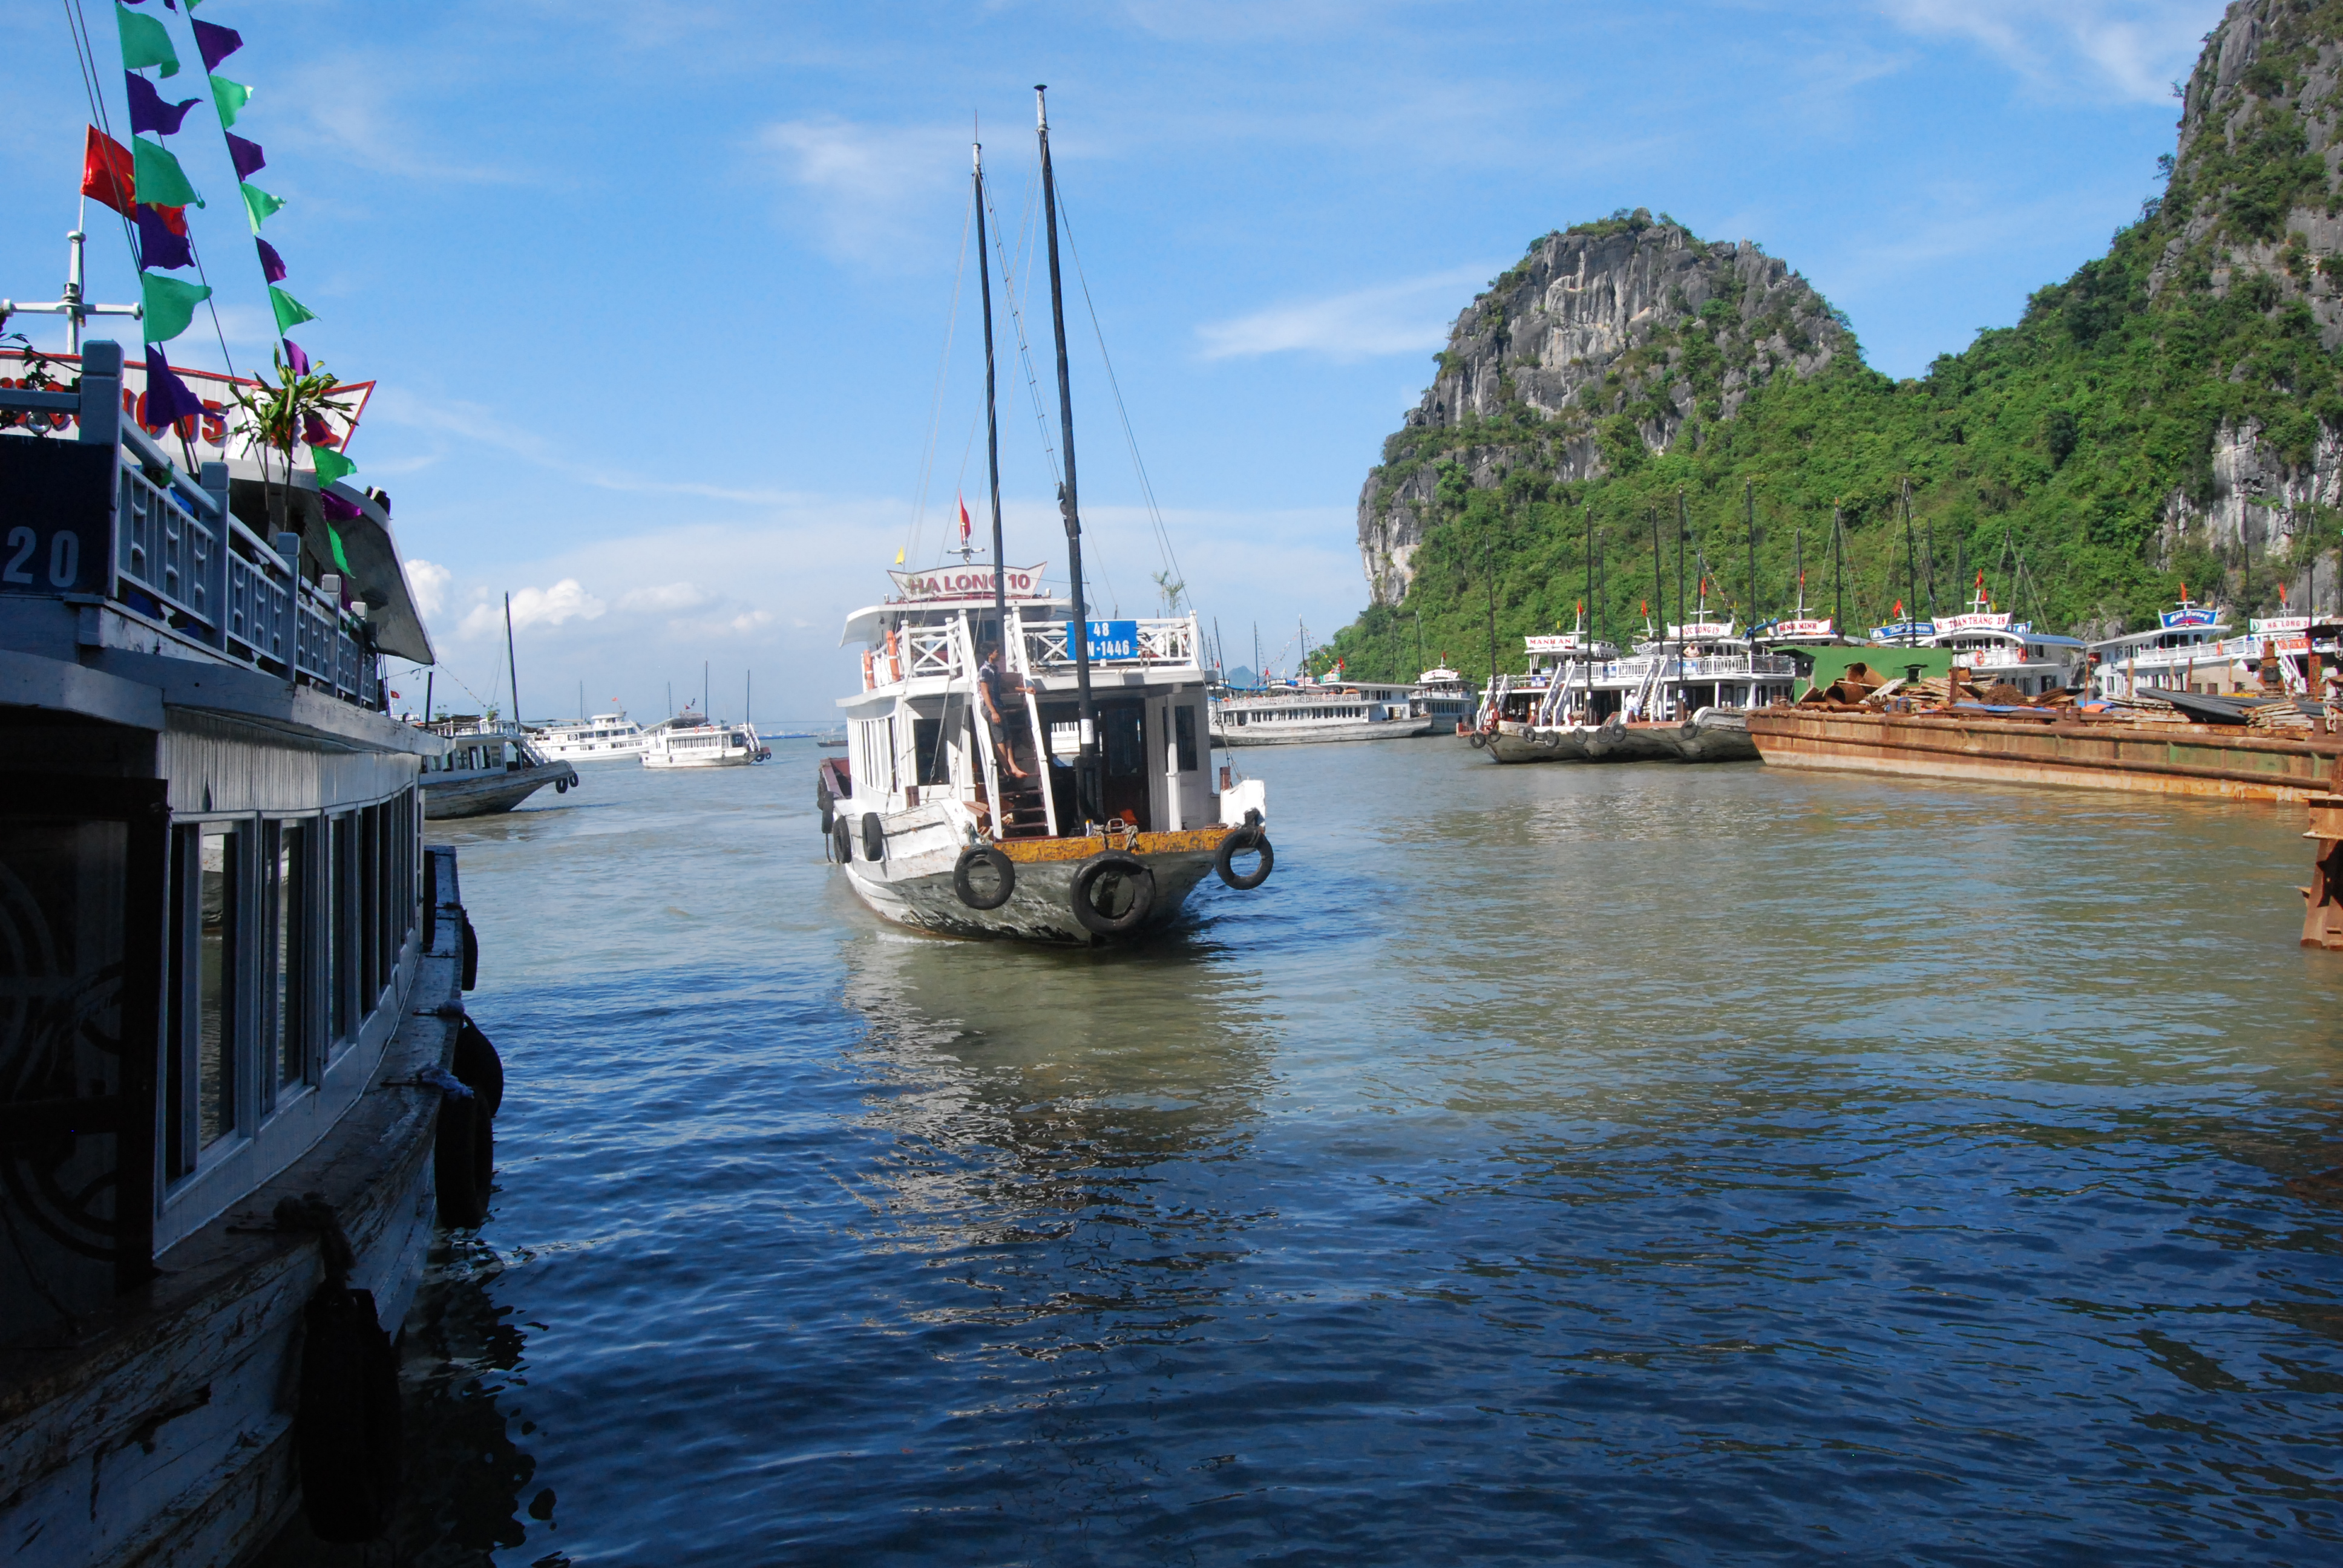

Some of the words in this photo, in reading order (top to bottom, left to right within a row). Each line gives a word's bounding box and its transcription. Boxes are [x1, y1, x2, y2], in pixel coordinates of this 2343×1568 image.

[1008, 573, 1031, 590] 10
[1997, 616, 2005, 625] 18
[1093, 622, 1110, 636] 48
[1087, 640, 1130, 656] N-1446
